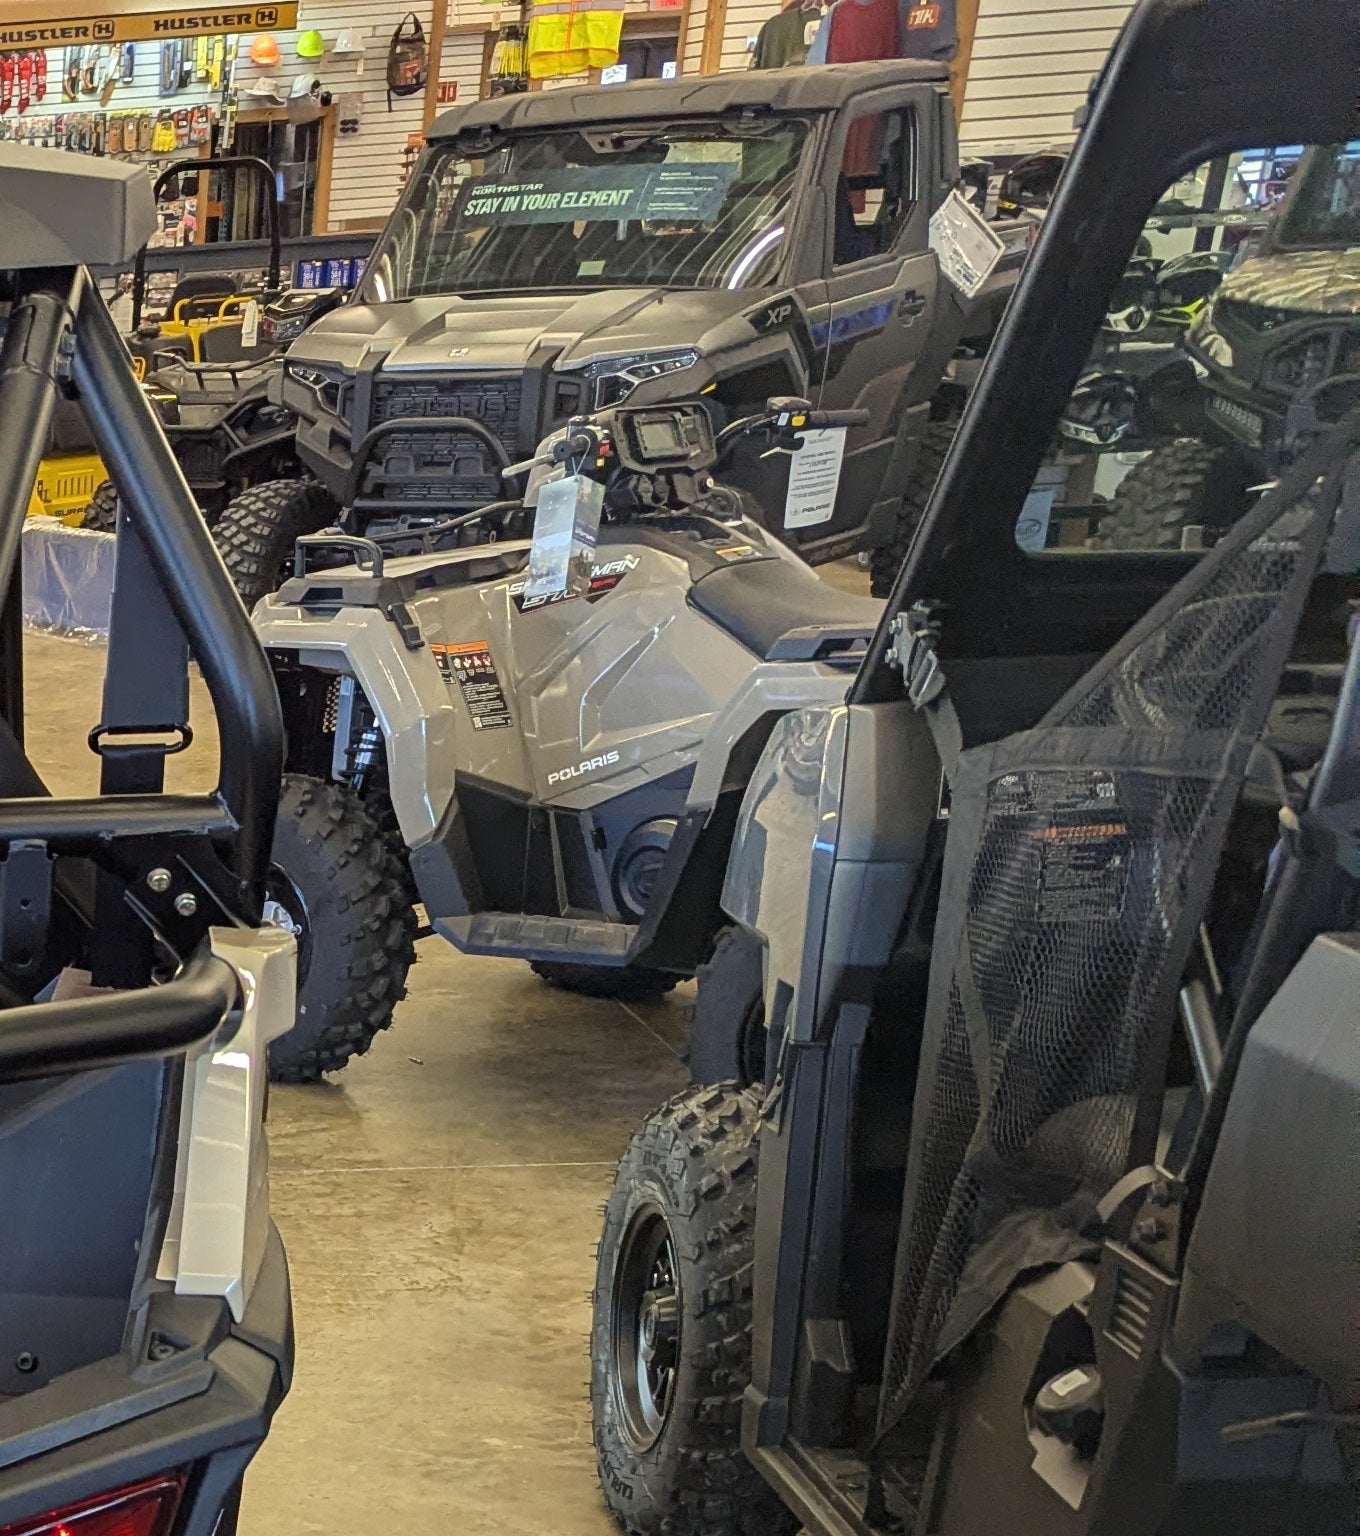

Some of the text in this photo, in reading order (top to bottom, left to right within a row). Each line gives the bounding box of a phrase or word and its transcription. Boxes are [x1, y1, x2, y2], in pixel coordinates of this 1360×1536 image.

[153, 13, 252, 32] HUSTLER
[472, 183, 543, 196] NORTHSTAR
[464, 197, 502, 217] STAY
[501, 196, 520, 213] IN
[521, 193, 561, 212] YOUR
[560, 189, 634, 208] ELEMENT
[765, 304, 792, 327] XP
[547, 750, 620, 786] POLARIS
